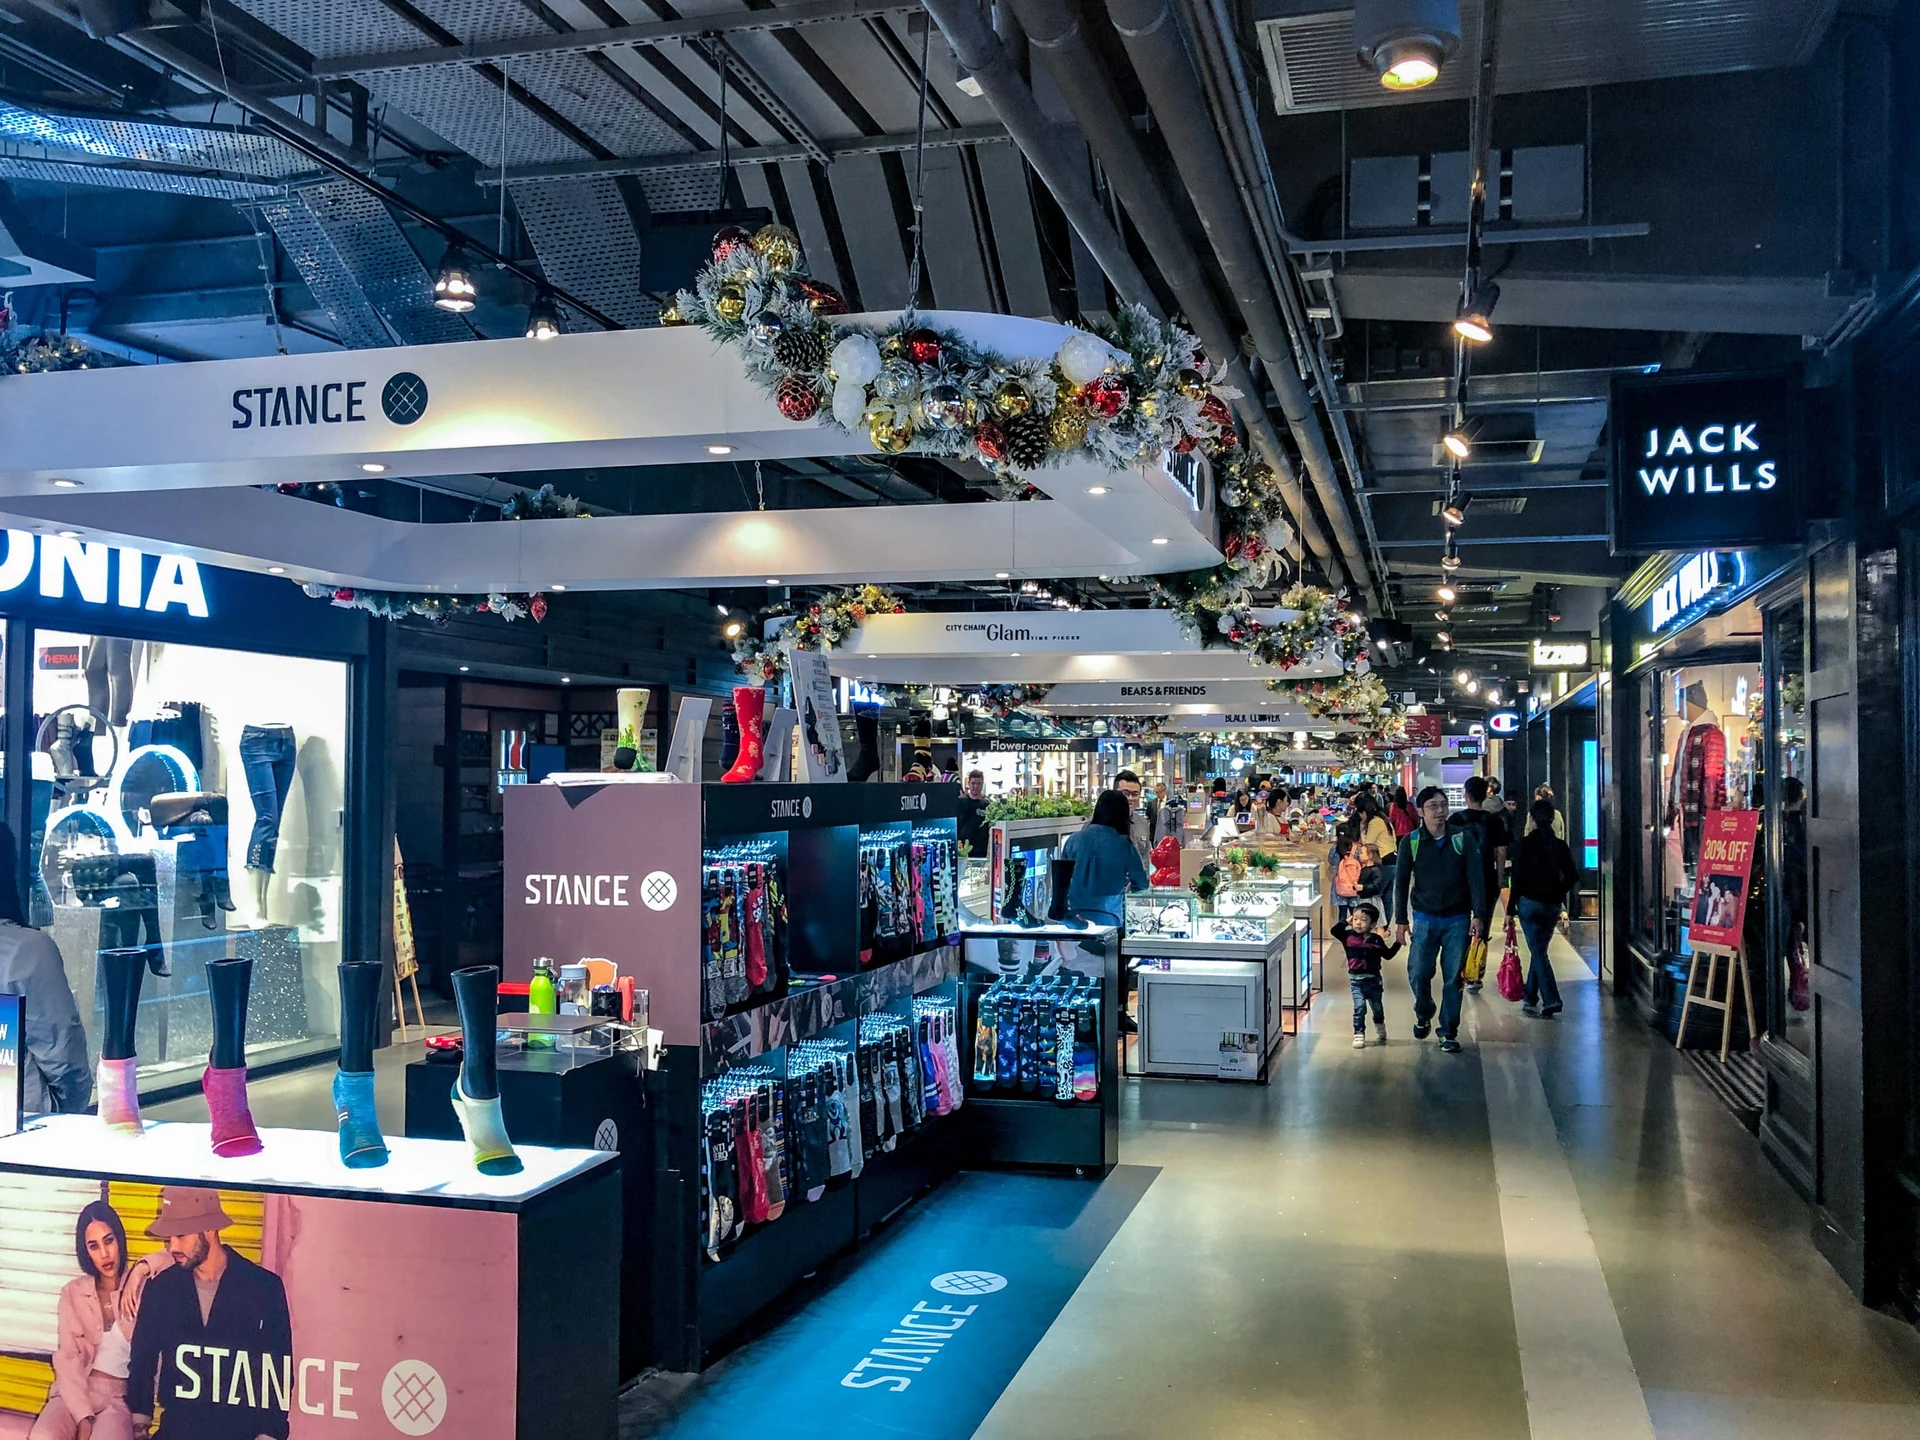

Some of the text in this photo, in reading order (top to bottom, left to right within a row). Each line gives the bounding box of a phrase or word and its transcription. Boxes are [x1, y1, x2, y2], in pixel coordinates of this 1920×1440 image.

[232, 381, 367, 429] STANCE
[1646, 422, 1760, 458] JACK
[1639, 461, 1777, 496] WILLS
[945, 624, 962, 632] CITY
[986, 624, 1030, 641] Glam
[1225, 714, 1247, 723] BLACK
[990, 740, 1069, 751] Flower MOUNTAIN
[771, 799, 800, 818] STANCE
[1704, 839, 1727, 860] 30%
[525, 874, 630, 906] STANCE
[840, 1300, 978, 1392] STANCE
[175, 1343, 361, 1420] STANCE
